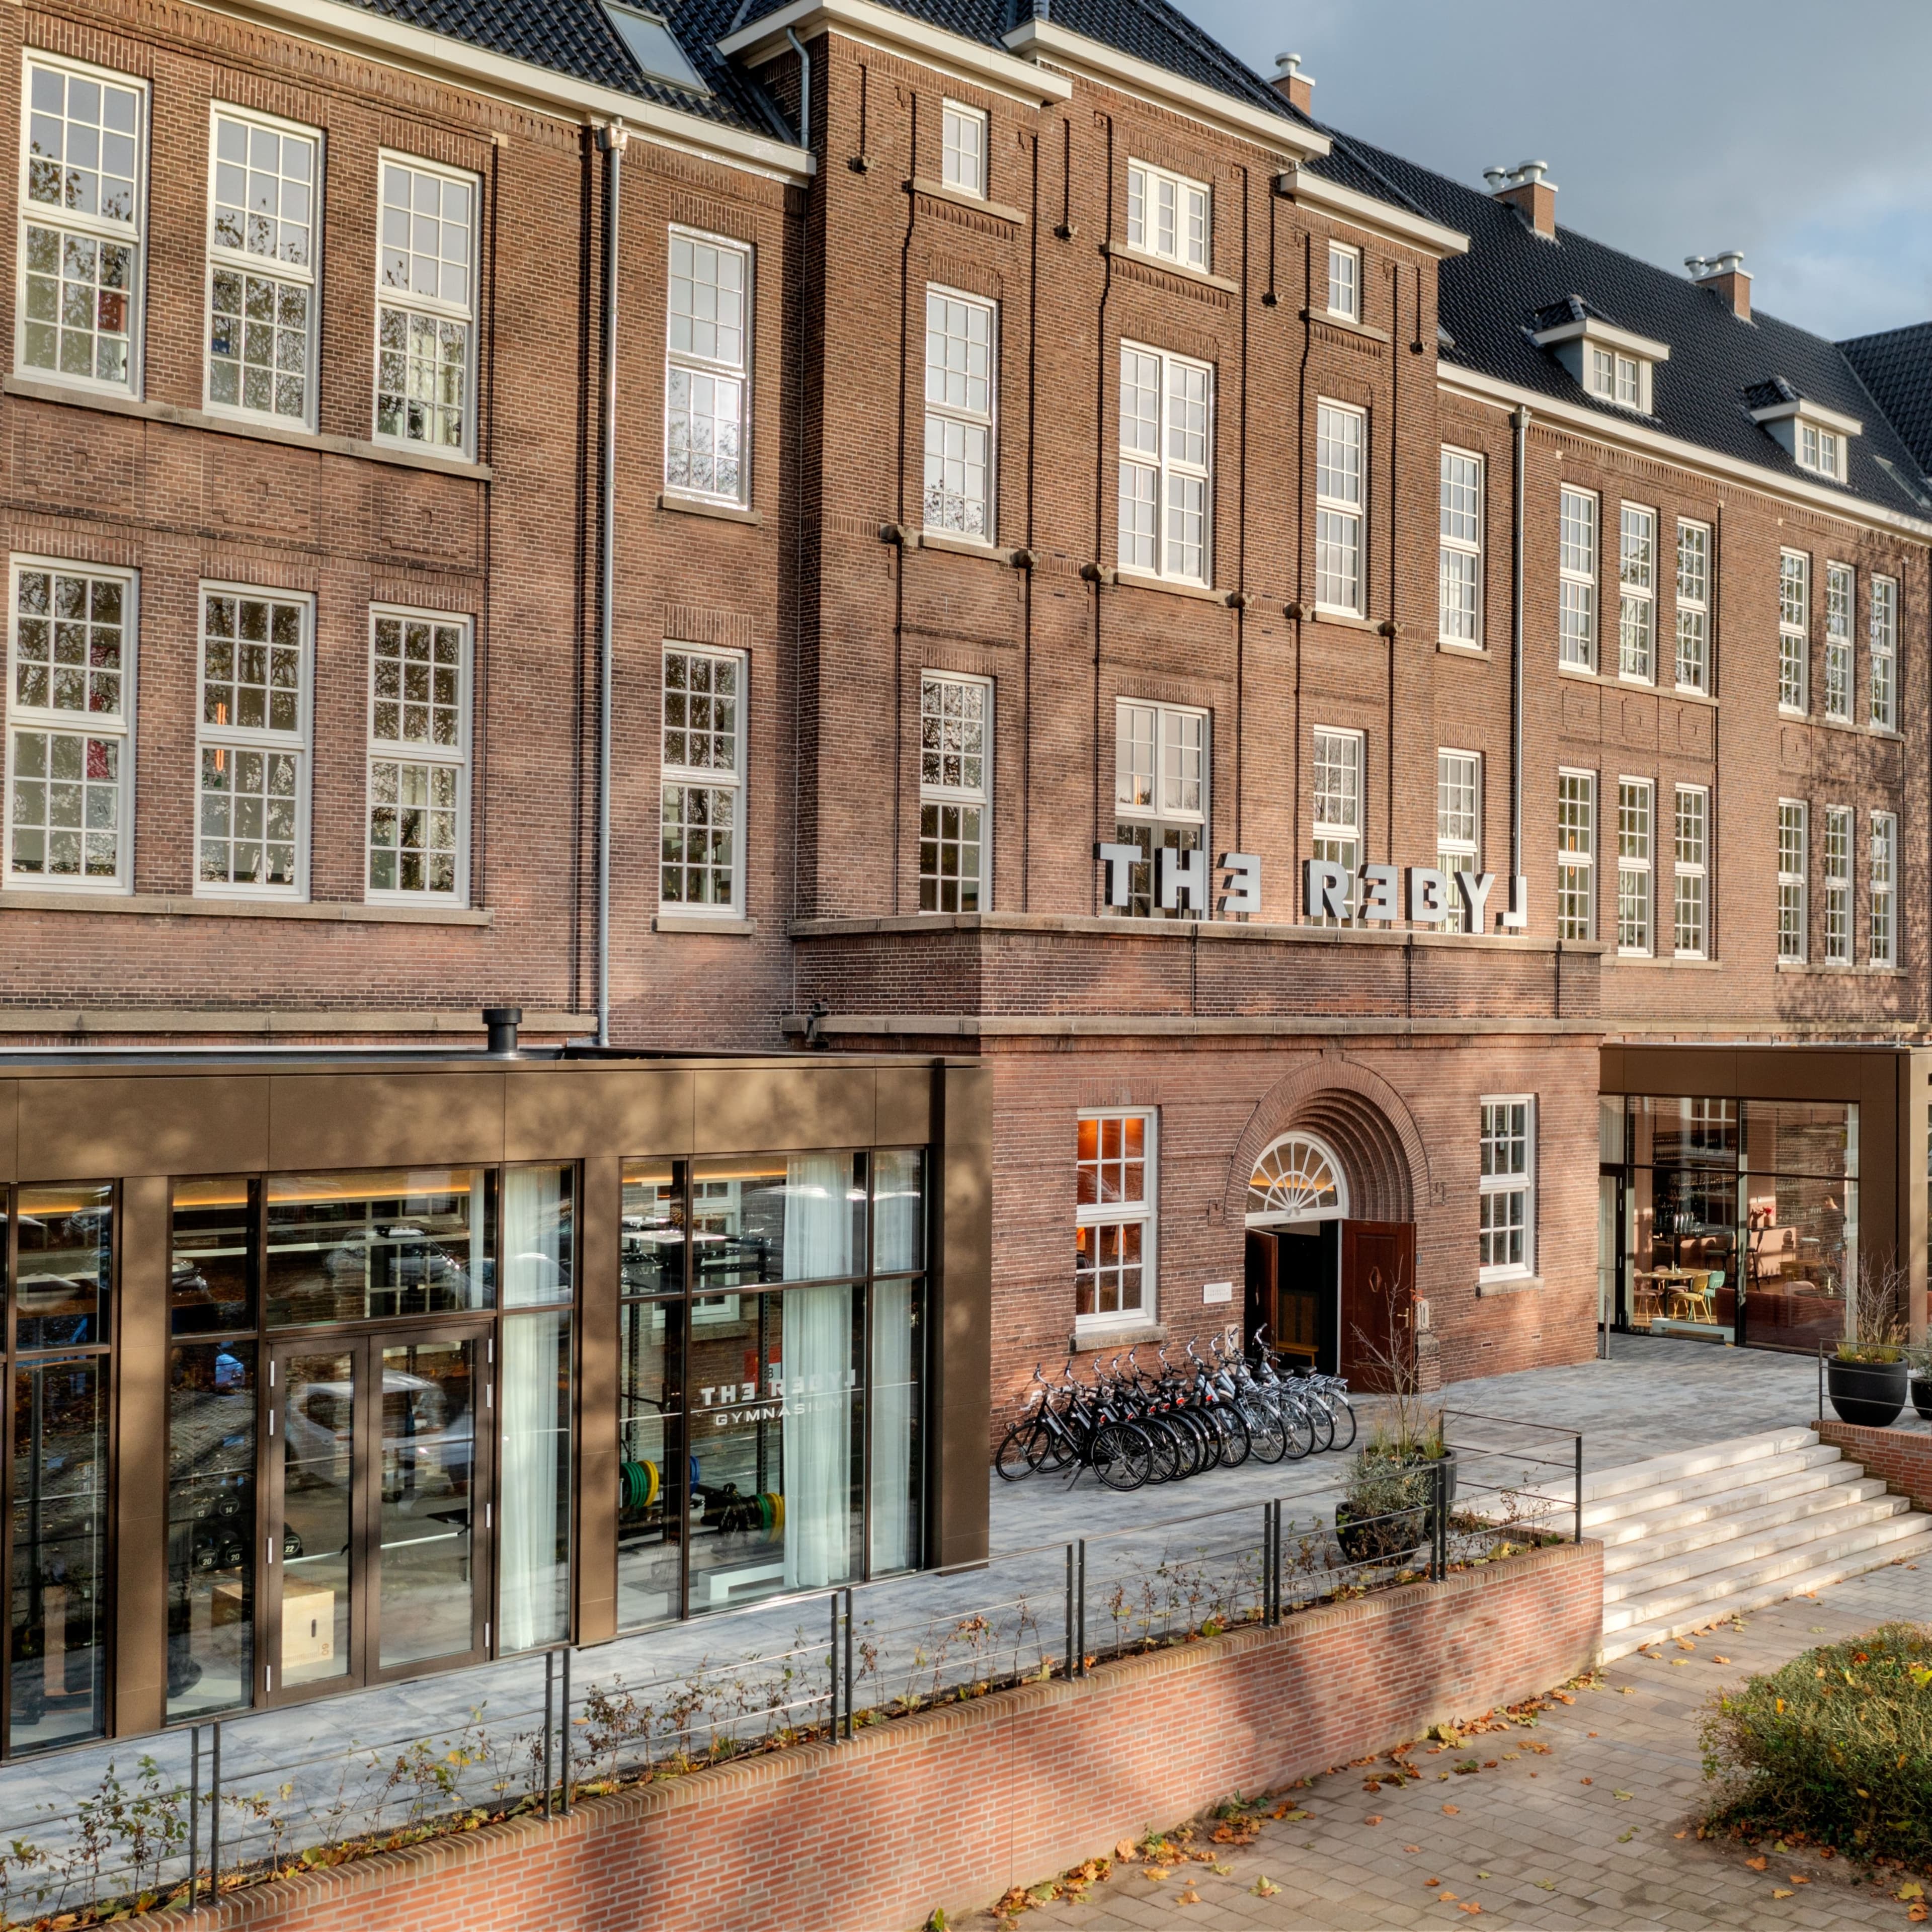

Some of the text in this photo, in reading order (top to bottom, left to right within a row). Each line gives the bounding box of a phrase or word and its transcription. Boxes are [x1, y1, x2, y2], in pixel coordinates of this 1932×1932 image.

[1093, 842, 1261, 914] THE
[701, 1382, 755, 1406] THE
[715, 1397, 843, 1426] GYMNASIUM
[202, 1558, 212, 1566] 20
